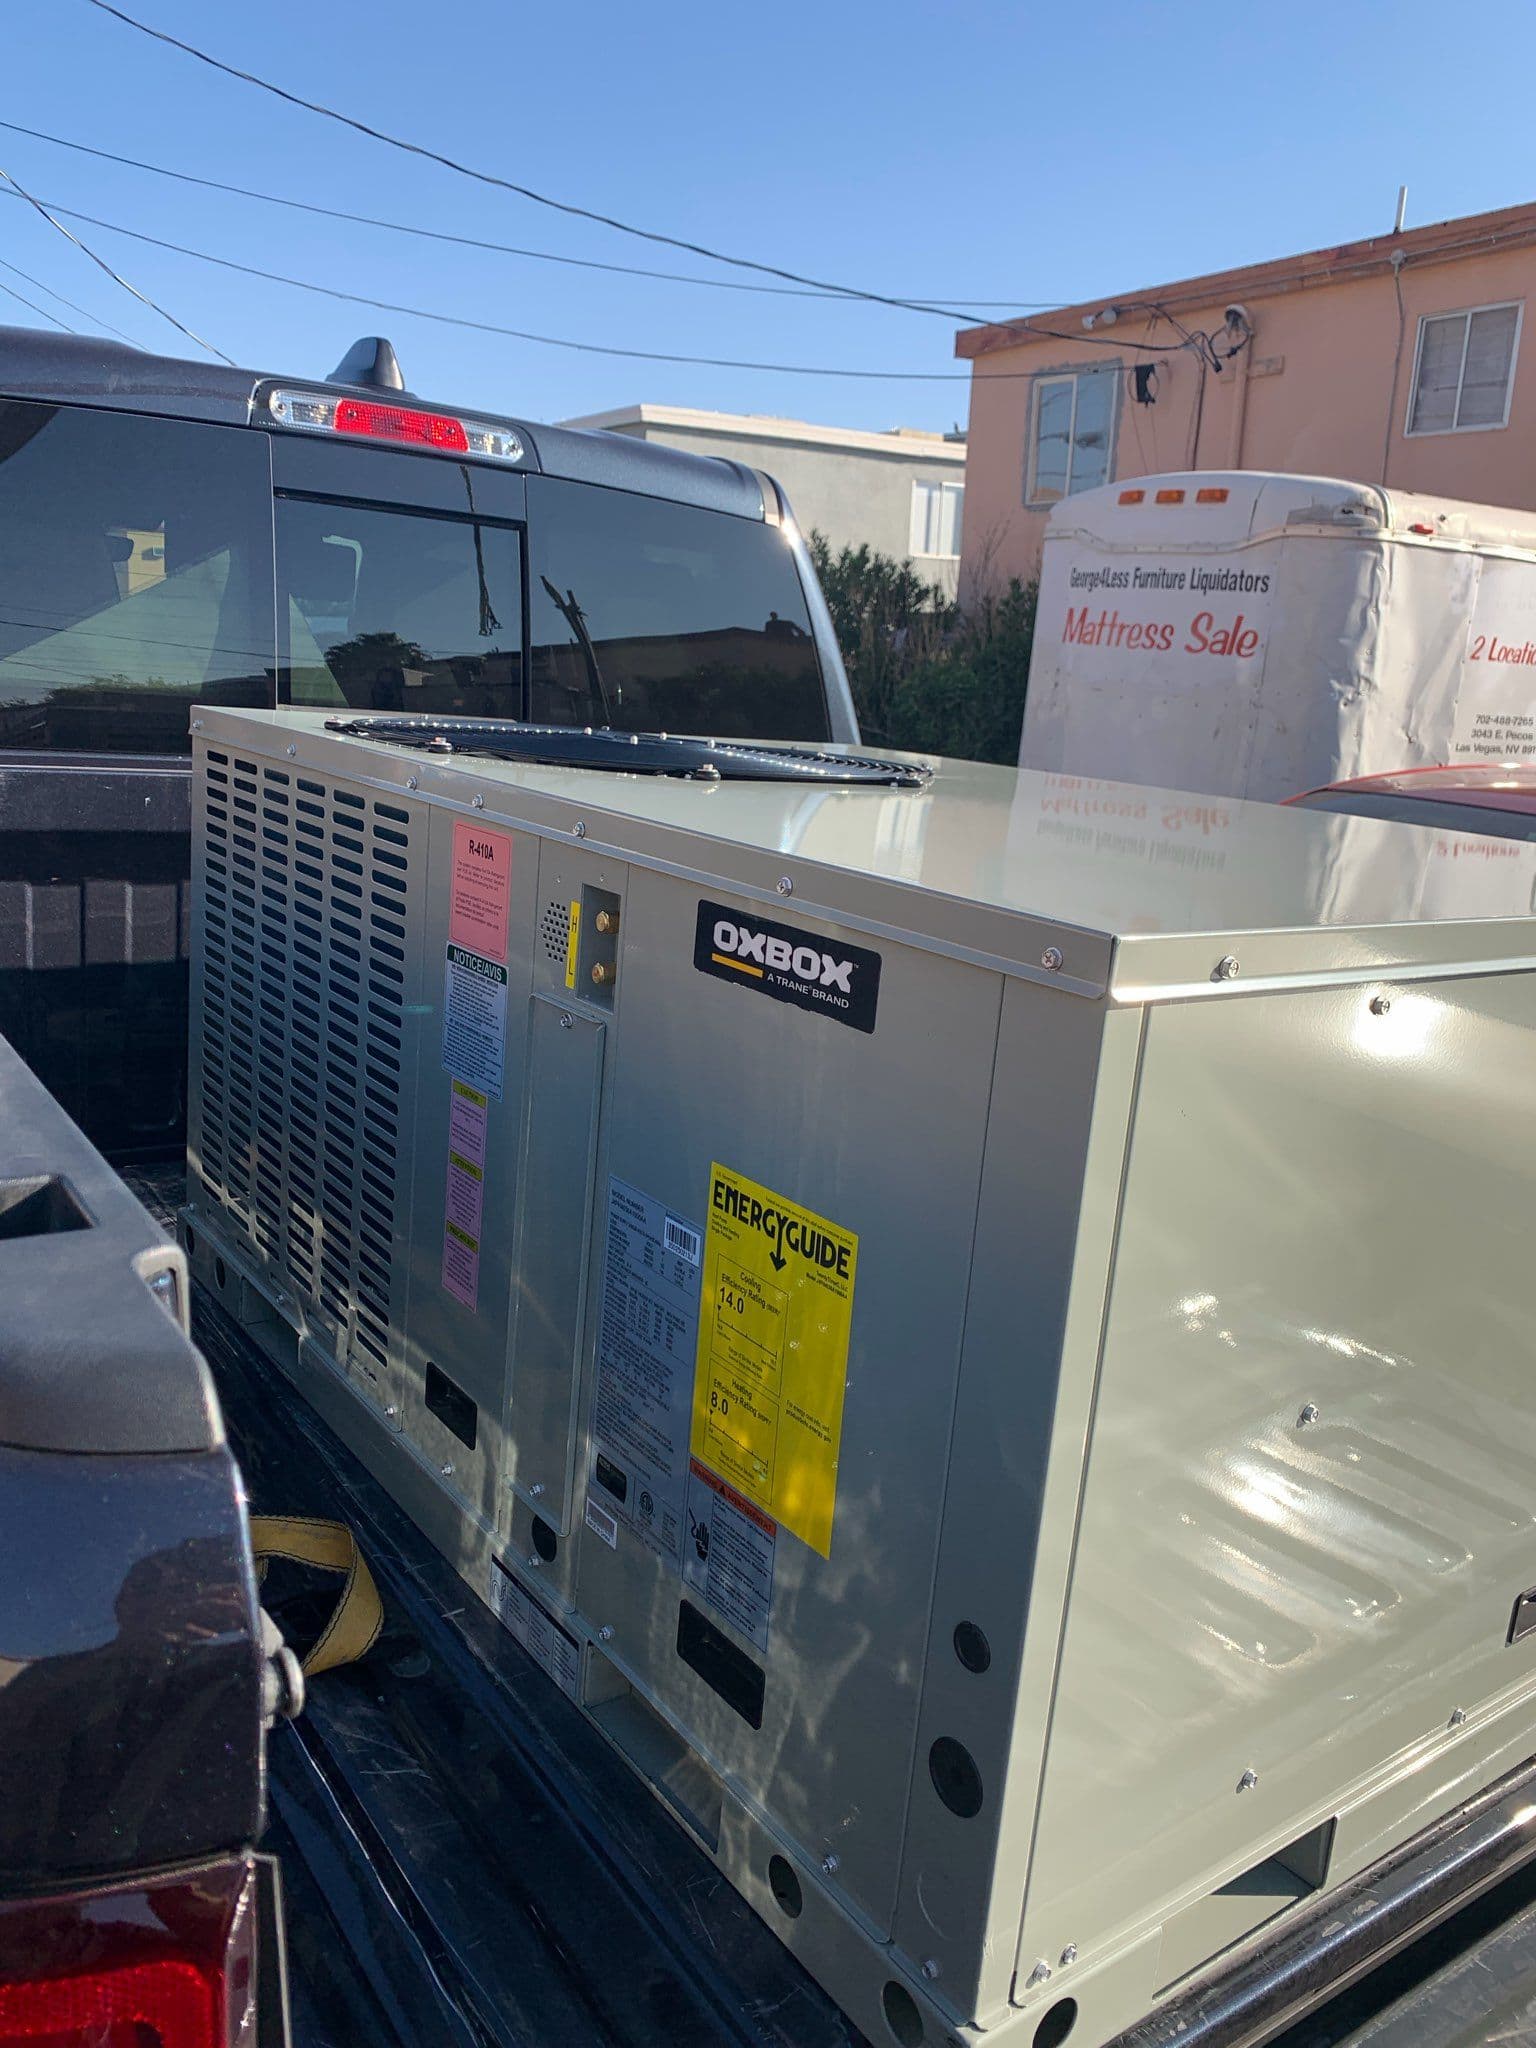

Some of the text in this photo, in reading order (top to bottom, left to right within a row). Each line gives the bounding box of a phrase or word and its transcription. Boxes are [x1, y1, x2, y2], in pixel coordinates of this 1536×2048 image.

[1132, 567, 1186, 590] Furniture
[1190, 567, 1270, 596] Liquidators
[1061, 606, 1259, 658] Mattress Sale
[1470, 635, 1486, 661] 2
[1455, 743, 1471, 753] Las
[1505, 744, 1520, 754] NV
[1505, 730, 1534, 740] Pecos
[468, 839, 494, 861] R-410A
[453, 949, 502, 982] NOTICE/AVIS
[767, 973, 775, 983] A
[812, 988, 849, 1009] BRAND
[722, 1273, 766, 1309] Efficiency Rating
[740, 1272, 762, 1293] Cooling
[720, 1286, 744, 1314] 14.0
[711, 1391, 728, 1415] 8.0
[713, 1378, 757, 1418] Efficiency Rating
[732, 1379, 752, 1401] Heating
